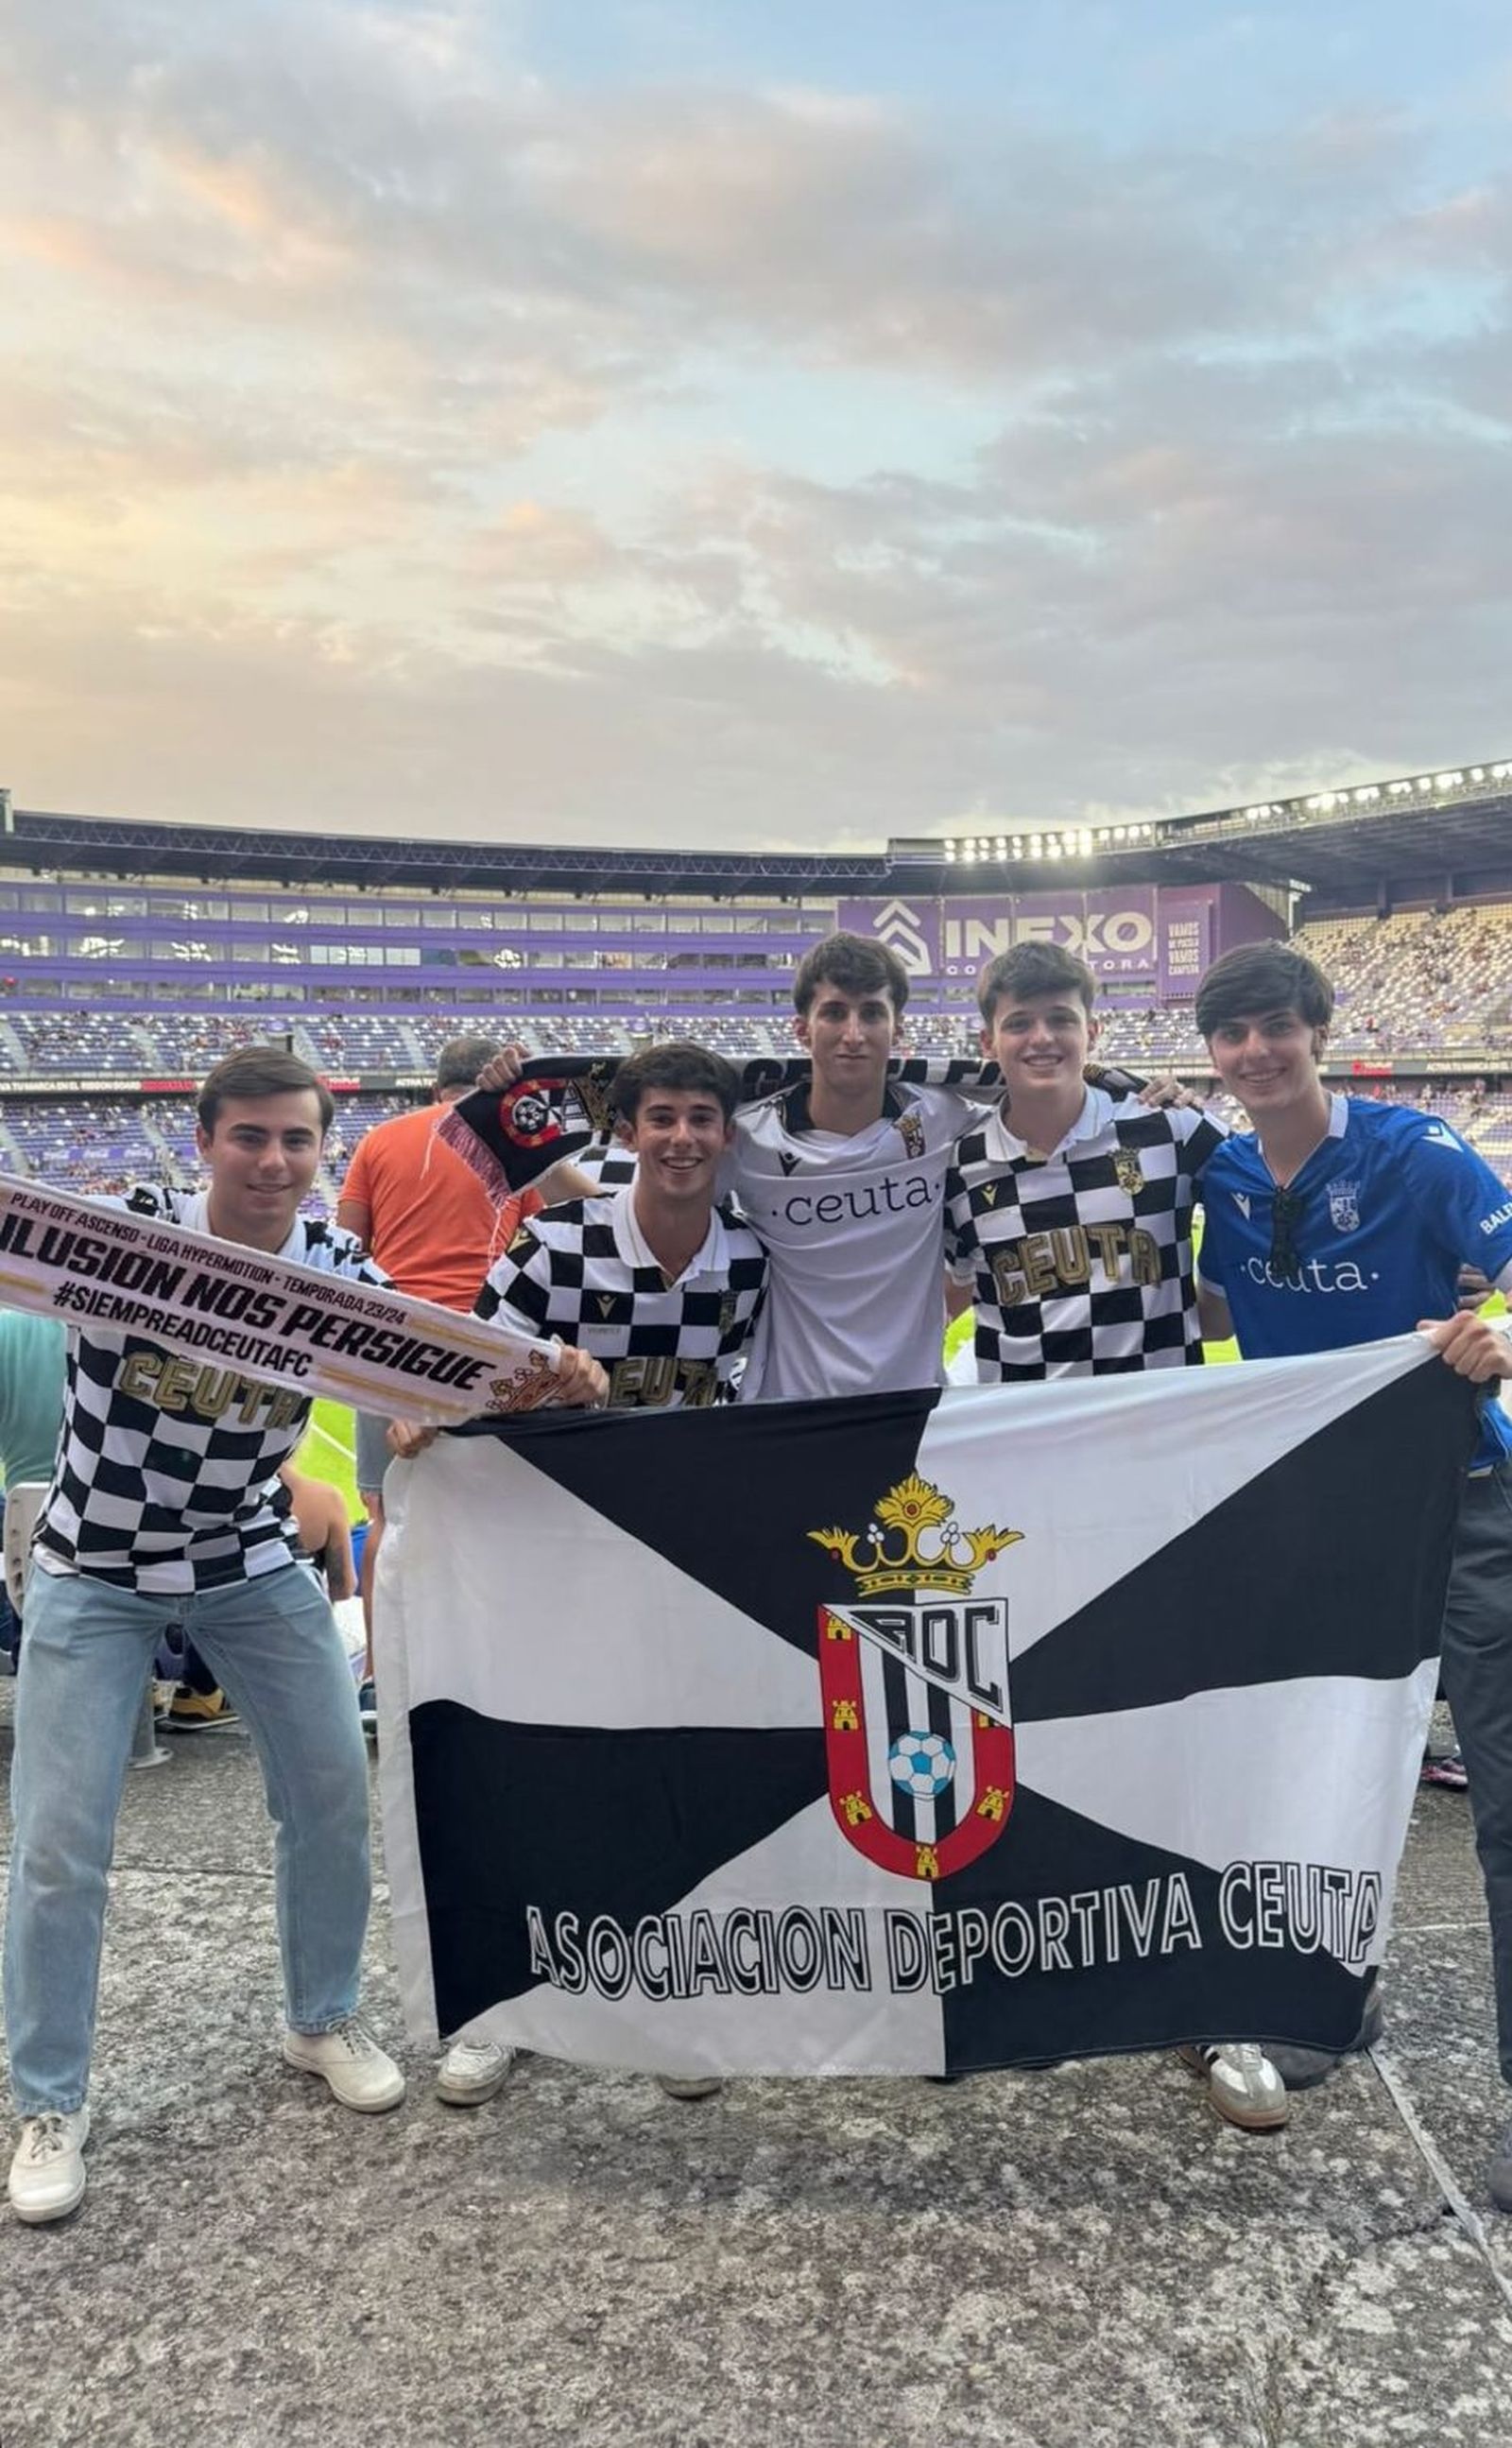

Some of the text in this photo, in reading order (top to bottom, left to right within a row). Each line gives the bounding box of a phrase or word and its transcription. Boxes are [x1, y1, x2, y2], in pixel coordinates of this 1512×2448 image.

[947, 958, 1149, 975] COTORA
[10, 1193, 50, 1215] PLAY
[50, 1203, 77, 1223] OFF
[76, 1213, 140, 1244] ASCENSO
[146, 1233, 180, 1256] LIGA
[180, 1244, 275, 1284] HYPERMOTION
[283, 1275, 365, 1313] TEMPORADA
[364, 1301, 408, 1324] 23/24
[990, 1224, 1162, 1307] CEUTA
[53, 1281, 314, 1377] #SIEMPREADCEUTAFC
[180, 1272, 287, 1329] NOS
[282, 1303, 497, 1390] PERSIGUE
[119, 1352, 302, 1432] CEUTA
[525, 1860, 1383, 2002] ASOCIACION DEPORTIVA CEUTA
